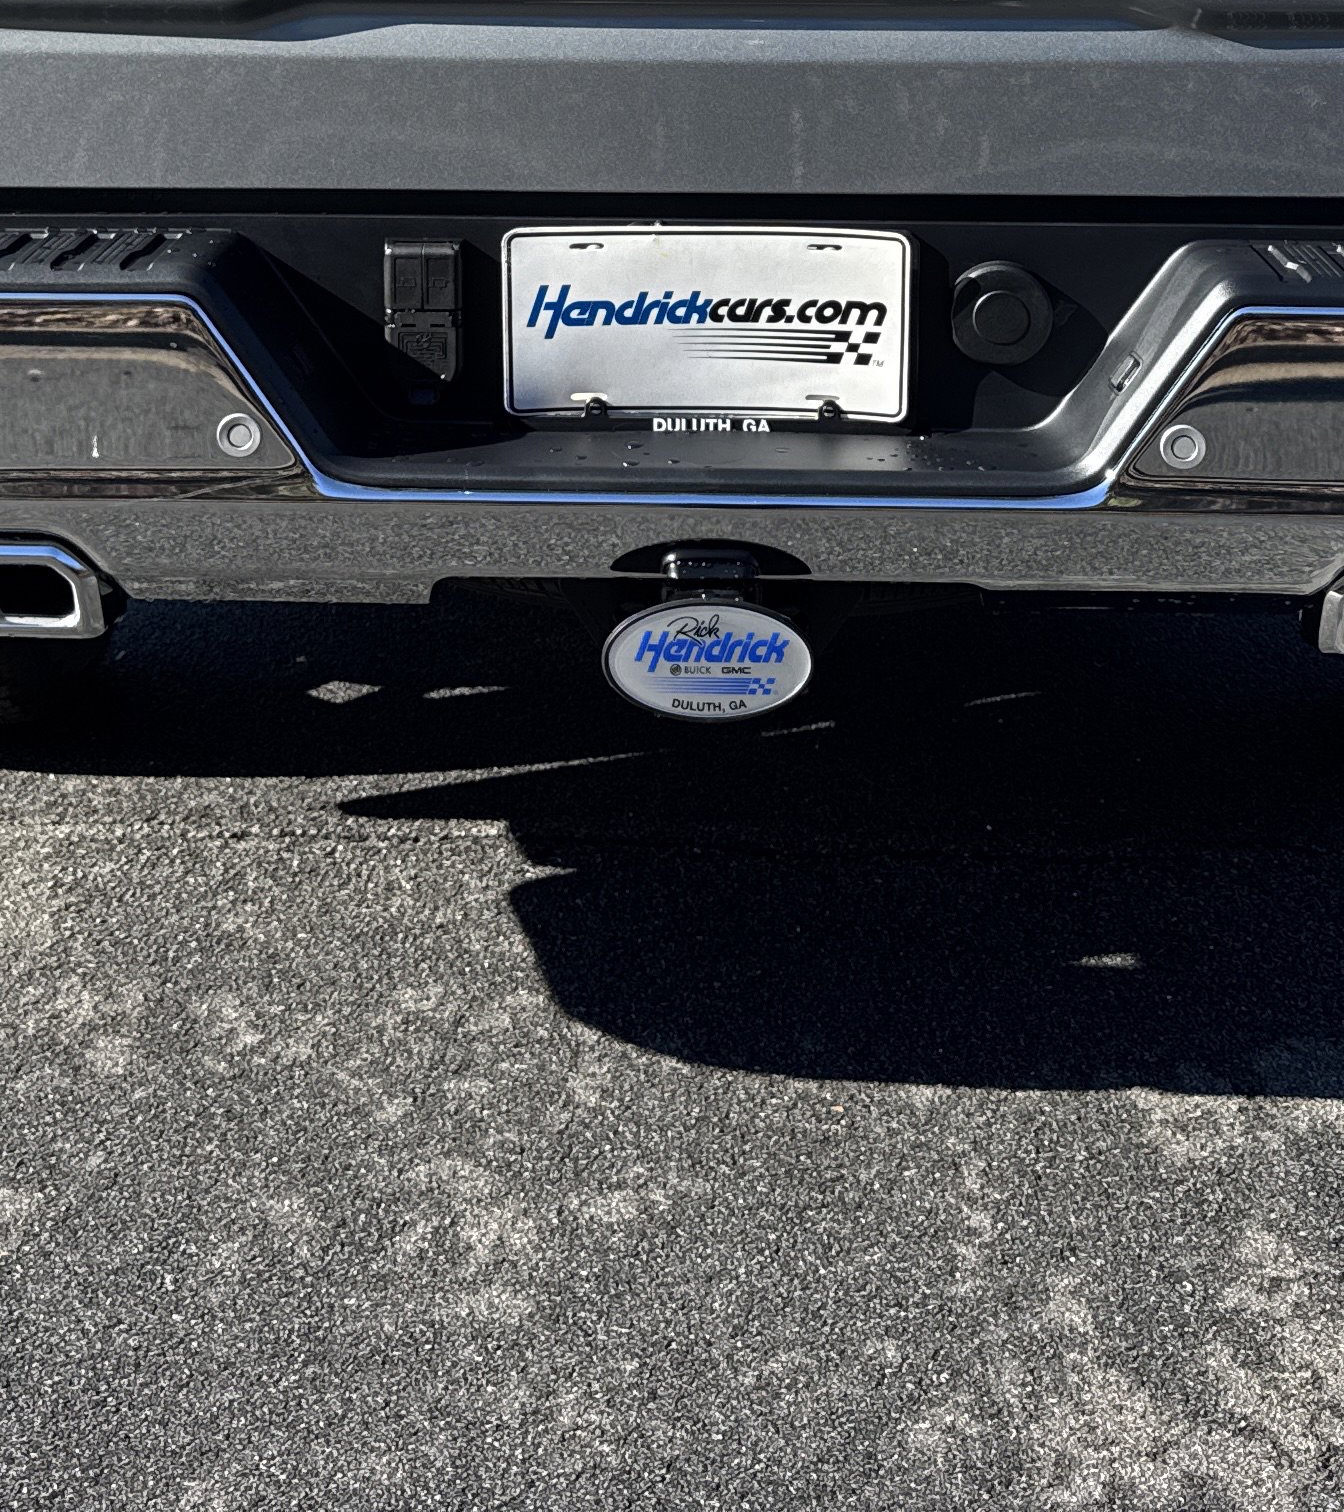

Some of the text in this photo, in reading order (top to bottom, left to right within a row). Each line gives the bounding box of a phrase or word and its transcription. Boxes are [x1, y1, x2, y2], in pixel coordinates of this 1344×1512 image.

[526, 284, 888, 339] Hendrickcars.com
[742, 418, 770, 433] GA
[667, 614, 720, 645] Rick
[634, 631, 790, 672] Hendrick
[684, 666, 752, 675] BUICK GMC
[672, 698, 747, 713] DULUTH, GA
